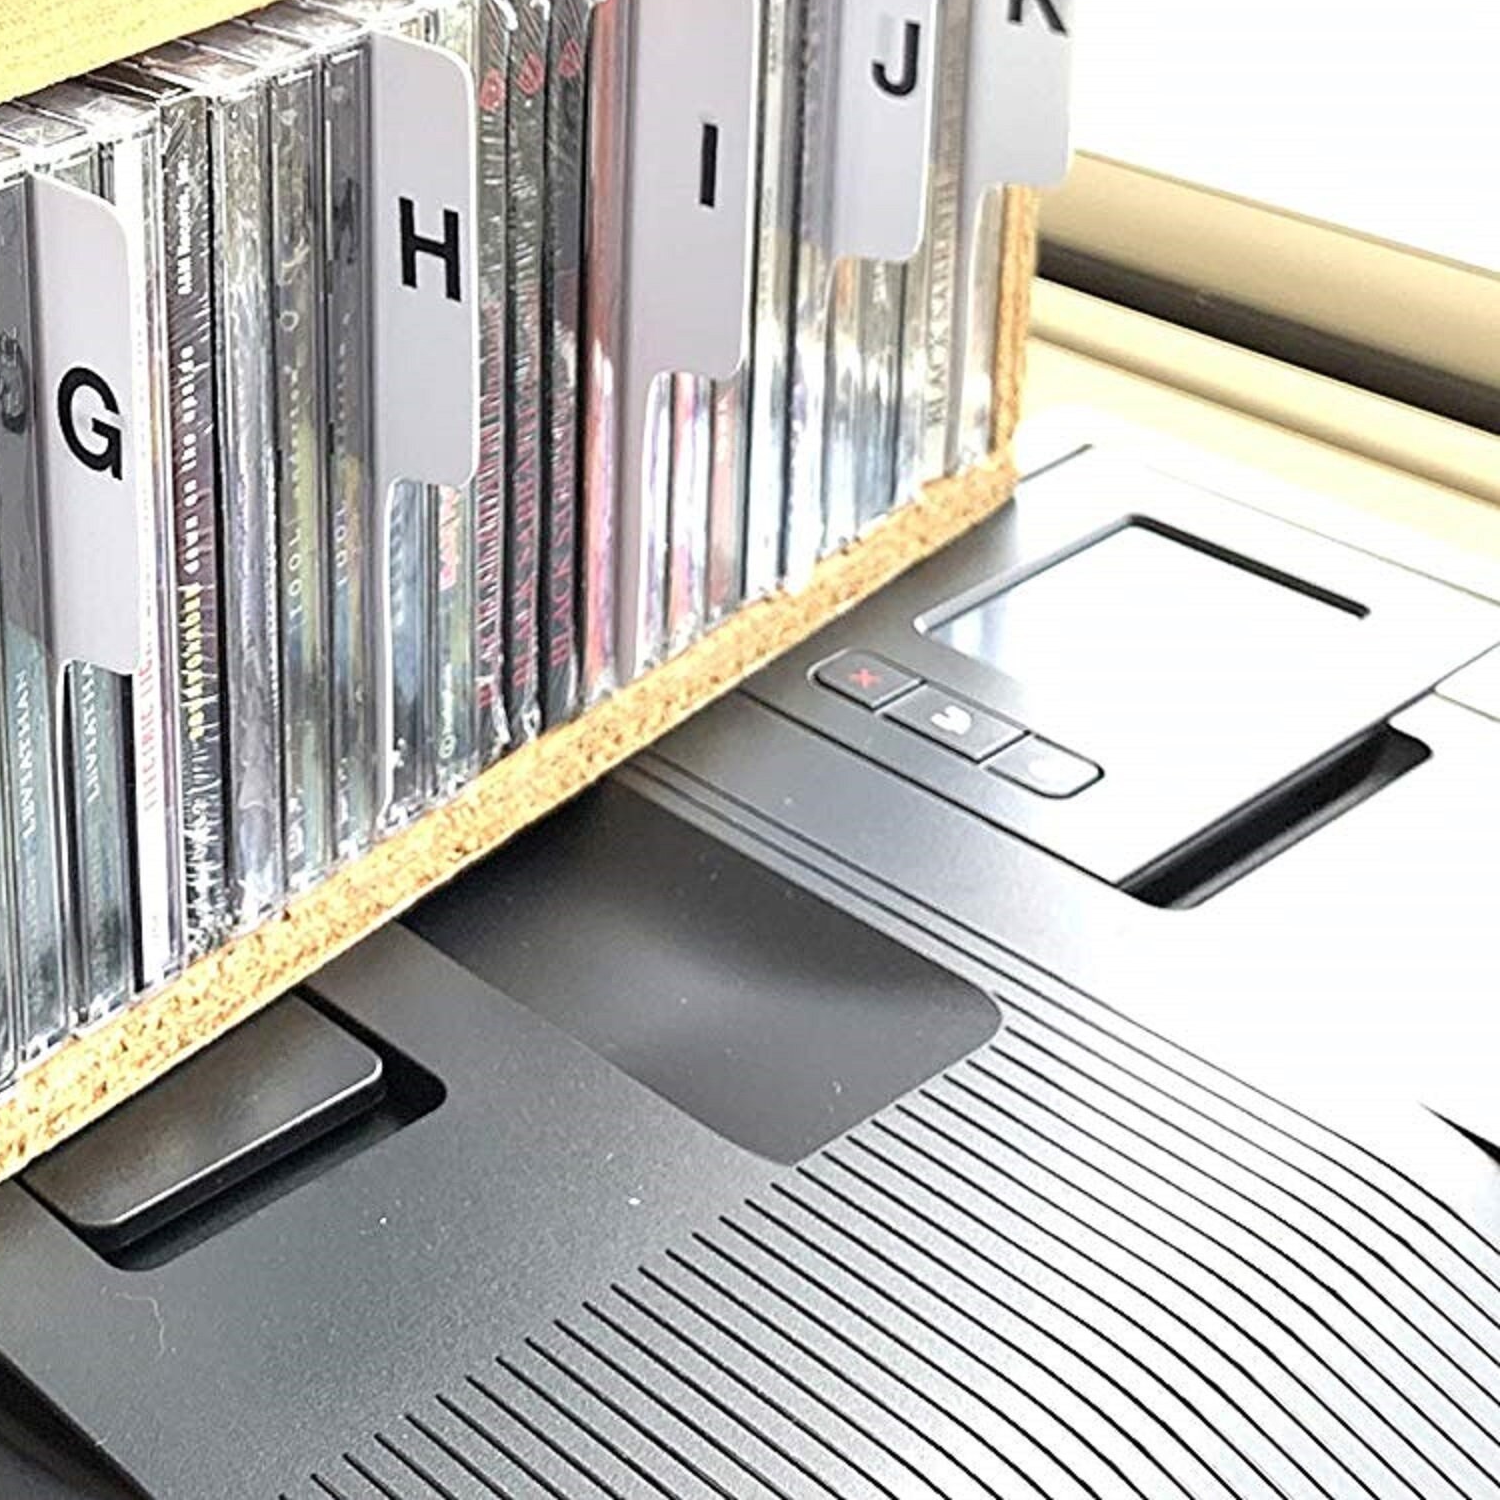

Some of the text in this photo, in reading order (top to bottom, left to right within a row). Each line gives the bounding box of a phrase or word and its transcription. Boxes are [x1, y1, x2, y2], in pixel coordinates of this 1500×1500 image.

[872, 21, 920, 98] J
[699, 123, 719, 209] I
[398, 196, 461, 303] H
[56, 366, 123, 481] G
[179, 344, 198, 422] upside
[180, 434, 197, 471] the
[183, 480, 198, 507] on
[288, 528, 304, 620] TOOL
[551, 555, 571, 666] BLACK
[14, 669, 37, 838] LEVIATHAN
[81, 662, 101, 802] LEVIATHA
